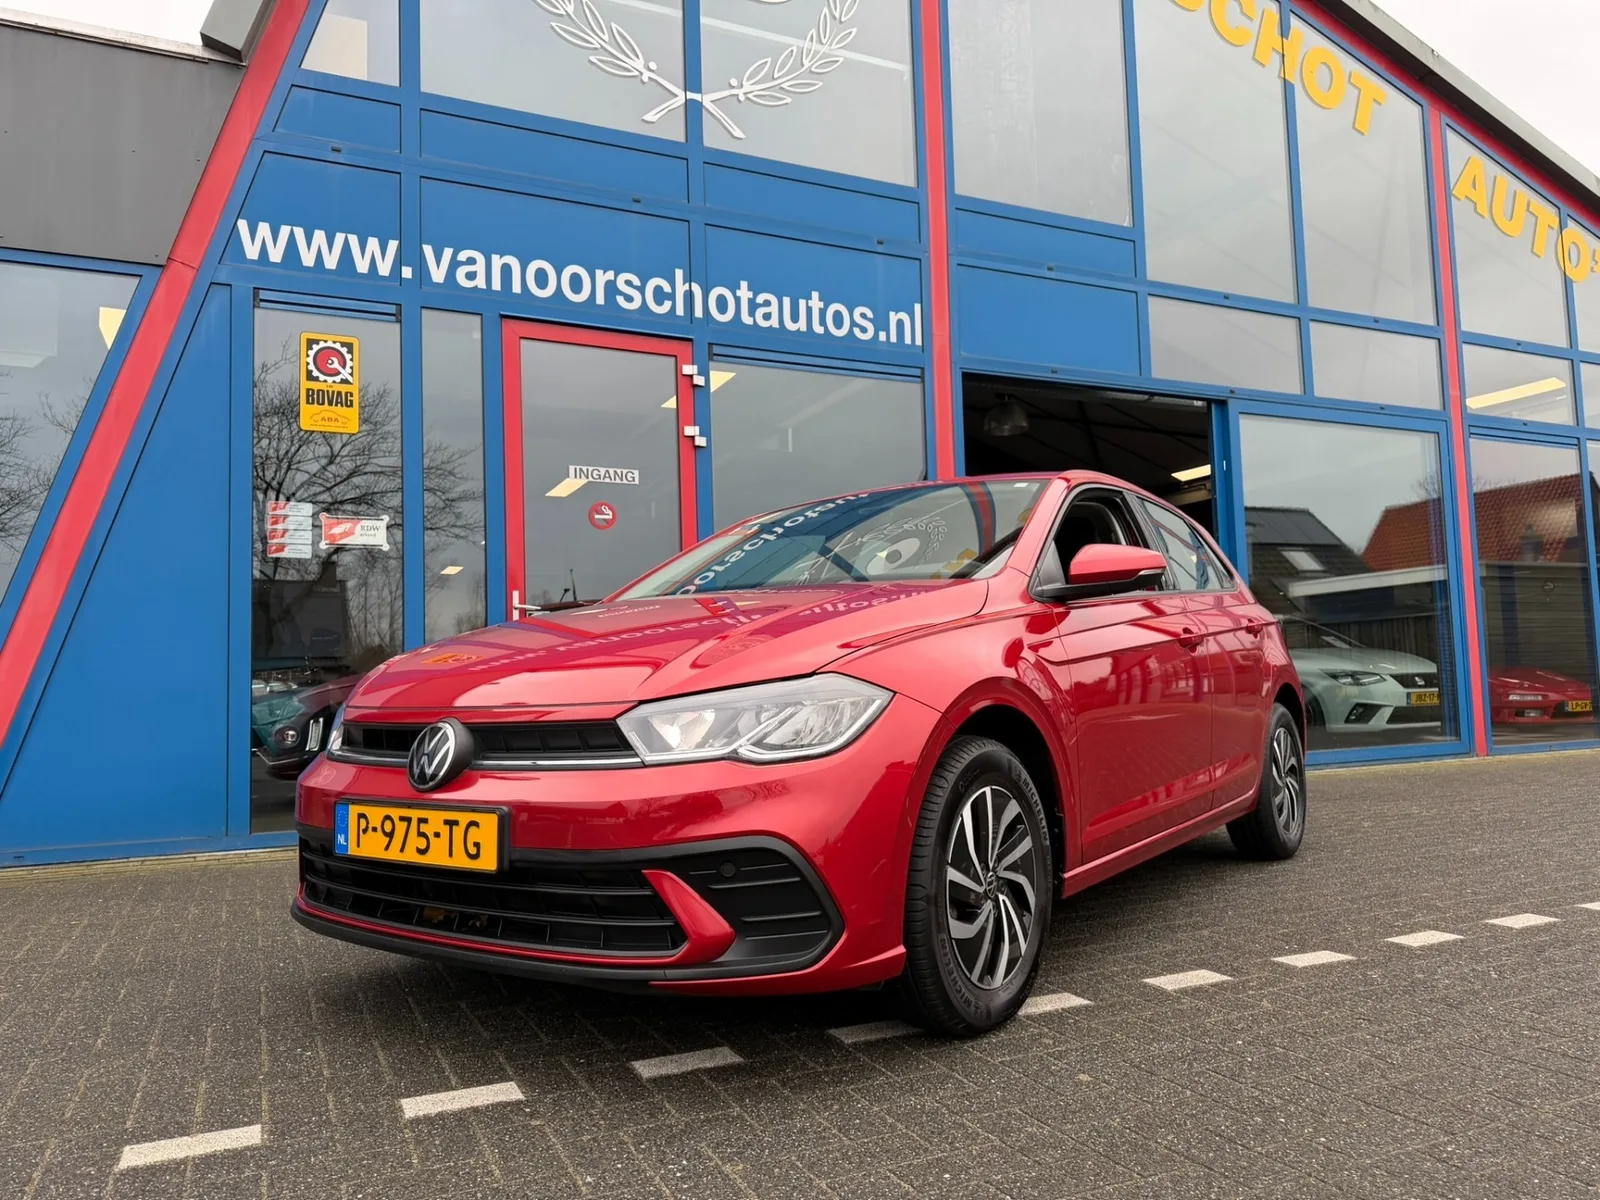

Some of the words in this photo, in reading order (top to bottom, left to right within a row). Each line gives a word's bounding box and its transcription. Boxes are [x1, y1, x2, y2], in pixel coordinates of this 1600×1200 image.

[1170, 0, 1387, 135] CHOT
[236, 218, 921, 346] www.vanoorschotautos.nl
[306, 388, 353, 408] BOVAG
[574, 467, 636, 483] INGANG
[360, 525, 380, 533] RDW
[1021, 776, 1049, 842] MICHELIN
[337, 833, 347, 846] NL
[356, 812, 481, 860] P-975-TG
[939, 937, 975, 1009] MICHELIN
